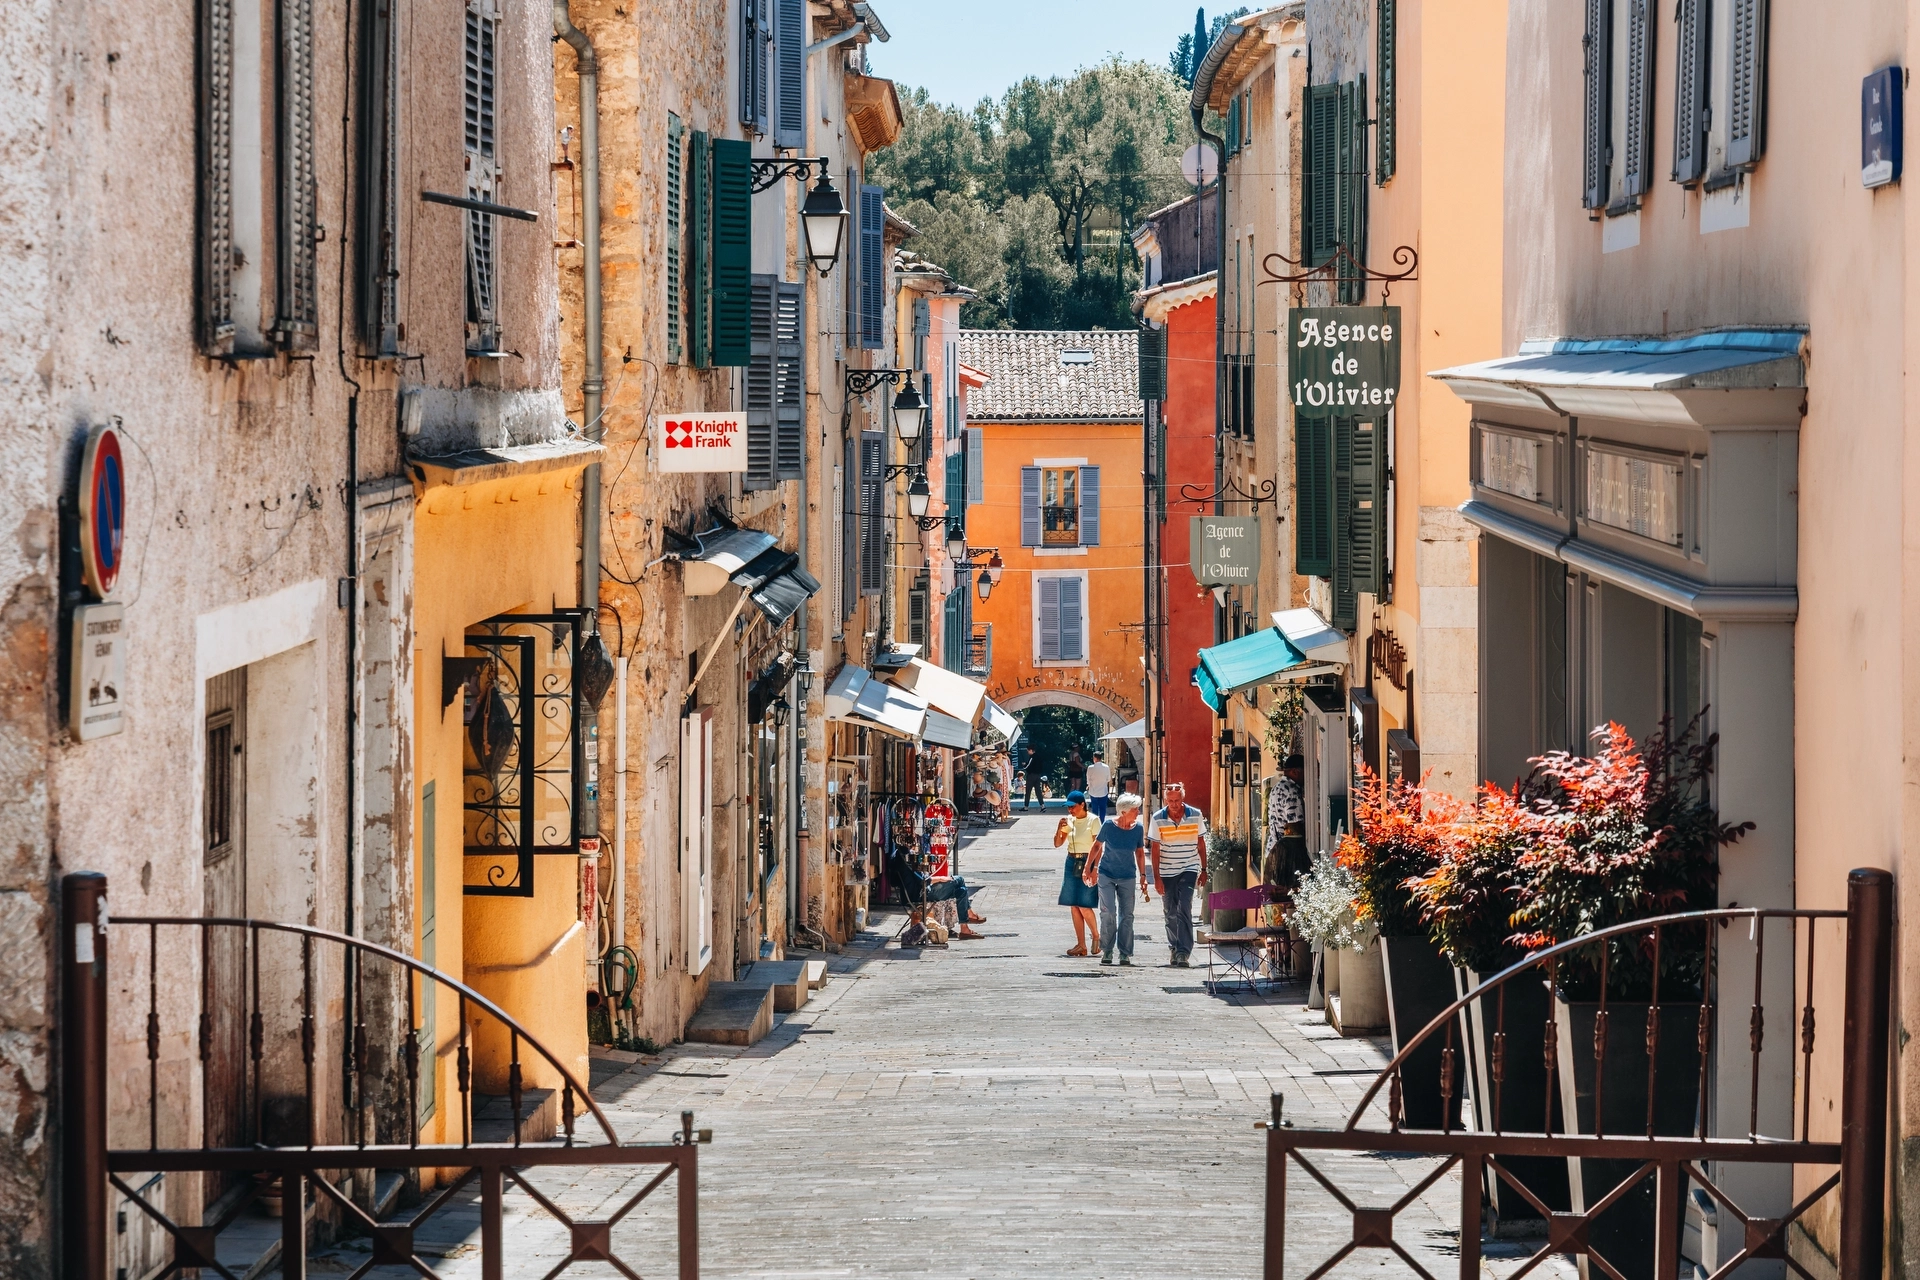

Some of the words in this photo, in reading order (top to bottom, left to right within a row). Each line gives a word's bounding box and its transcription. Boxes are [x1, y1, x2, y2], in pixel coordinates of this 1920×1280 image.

[1297, 318, 1393, 348] Agence
[1331, 351, 1358, 375] de
[695, 420, 738, 436] Knight
[695, 435, 732, 448] Frank
[1205, 524, 1244, 541] Agence
[1219, 544, 1231, 559] de
[986, 682, 1009, 701] tel
